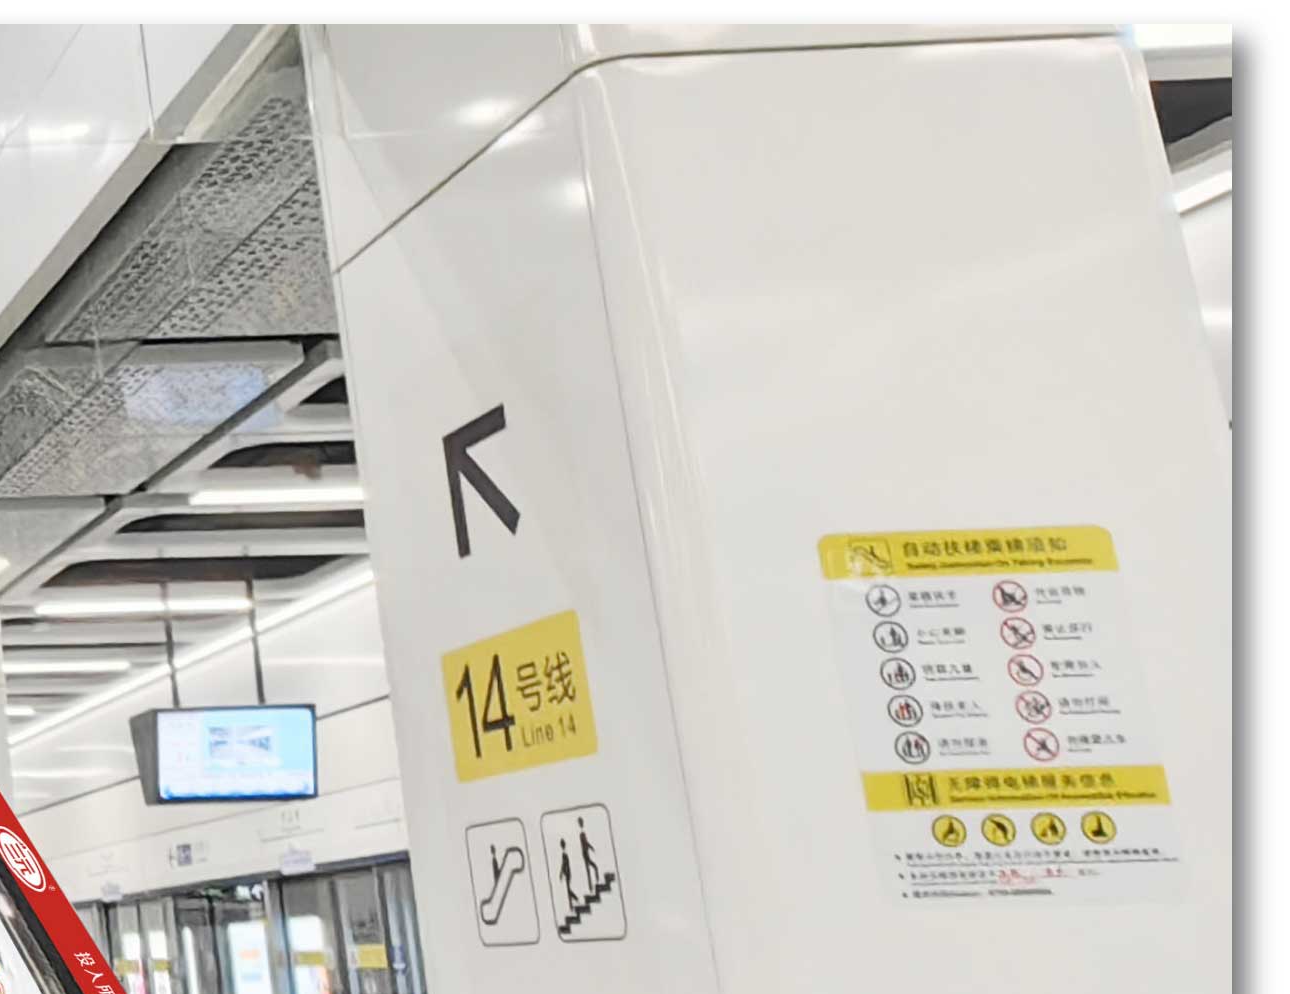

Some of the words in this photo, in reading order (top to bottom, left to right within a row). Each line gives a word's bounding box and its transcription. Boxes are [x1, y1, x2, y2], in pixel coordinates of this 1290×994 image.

[455, 651, 577, 759] 14号线
[522, 725, 555, 749] Line
[558, 713, 578, 738] 14
